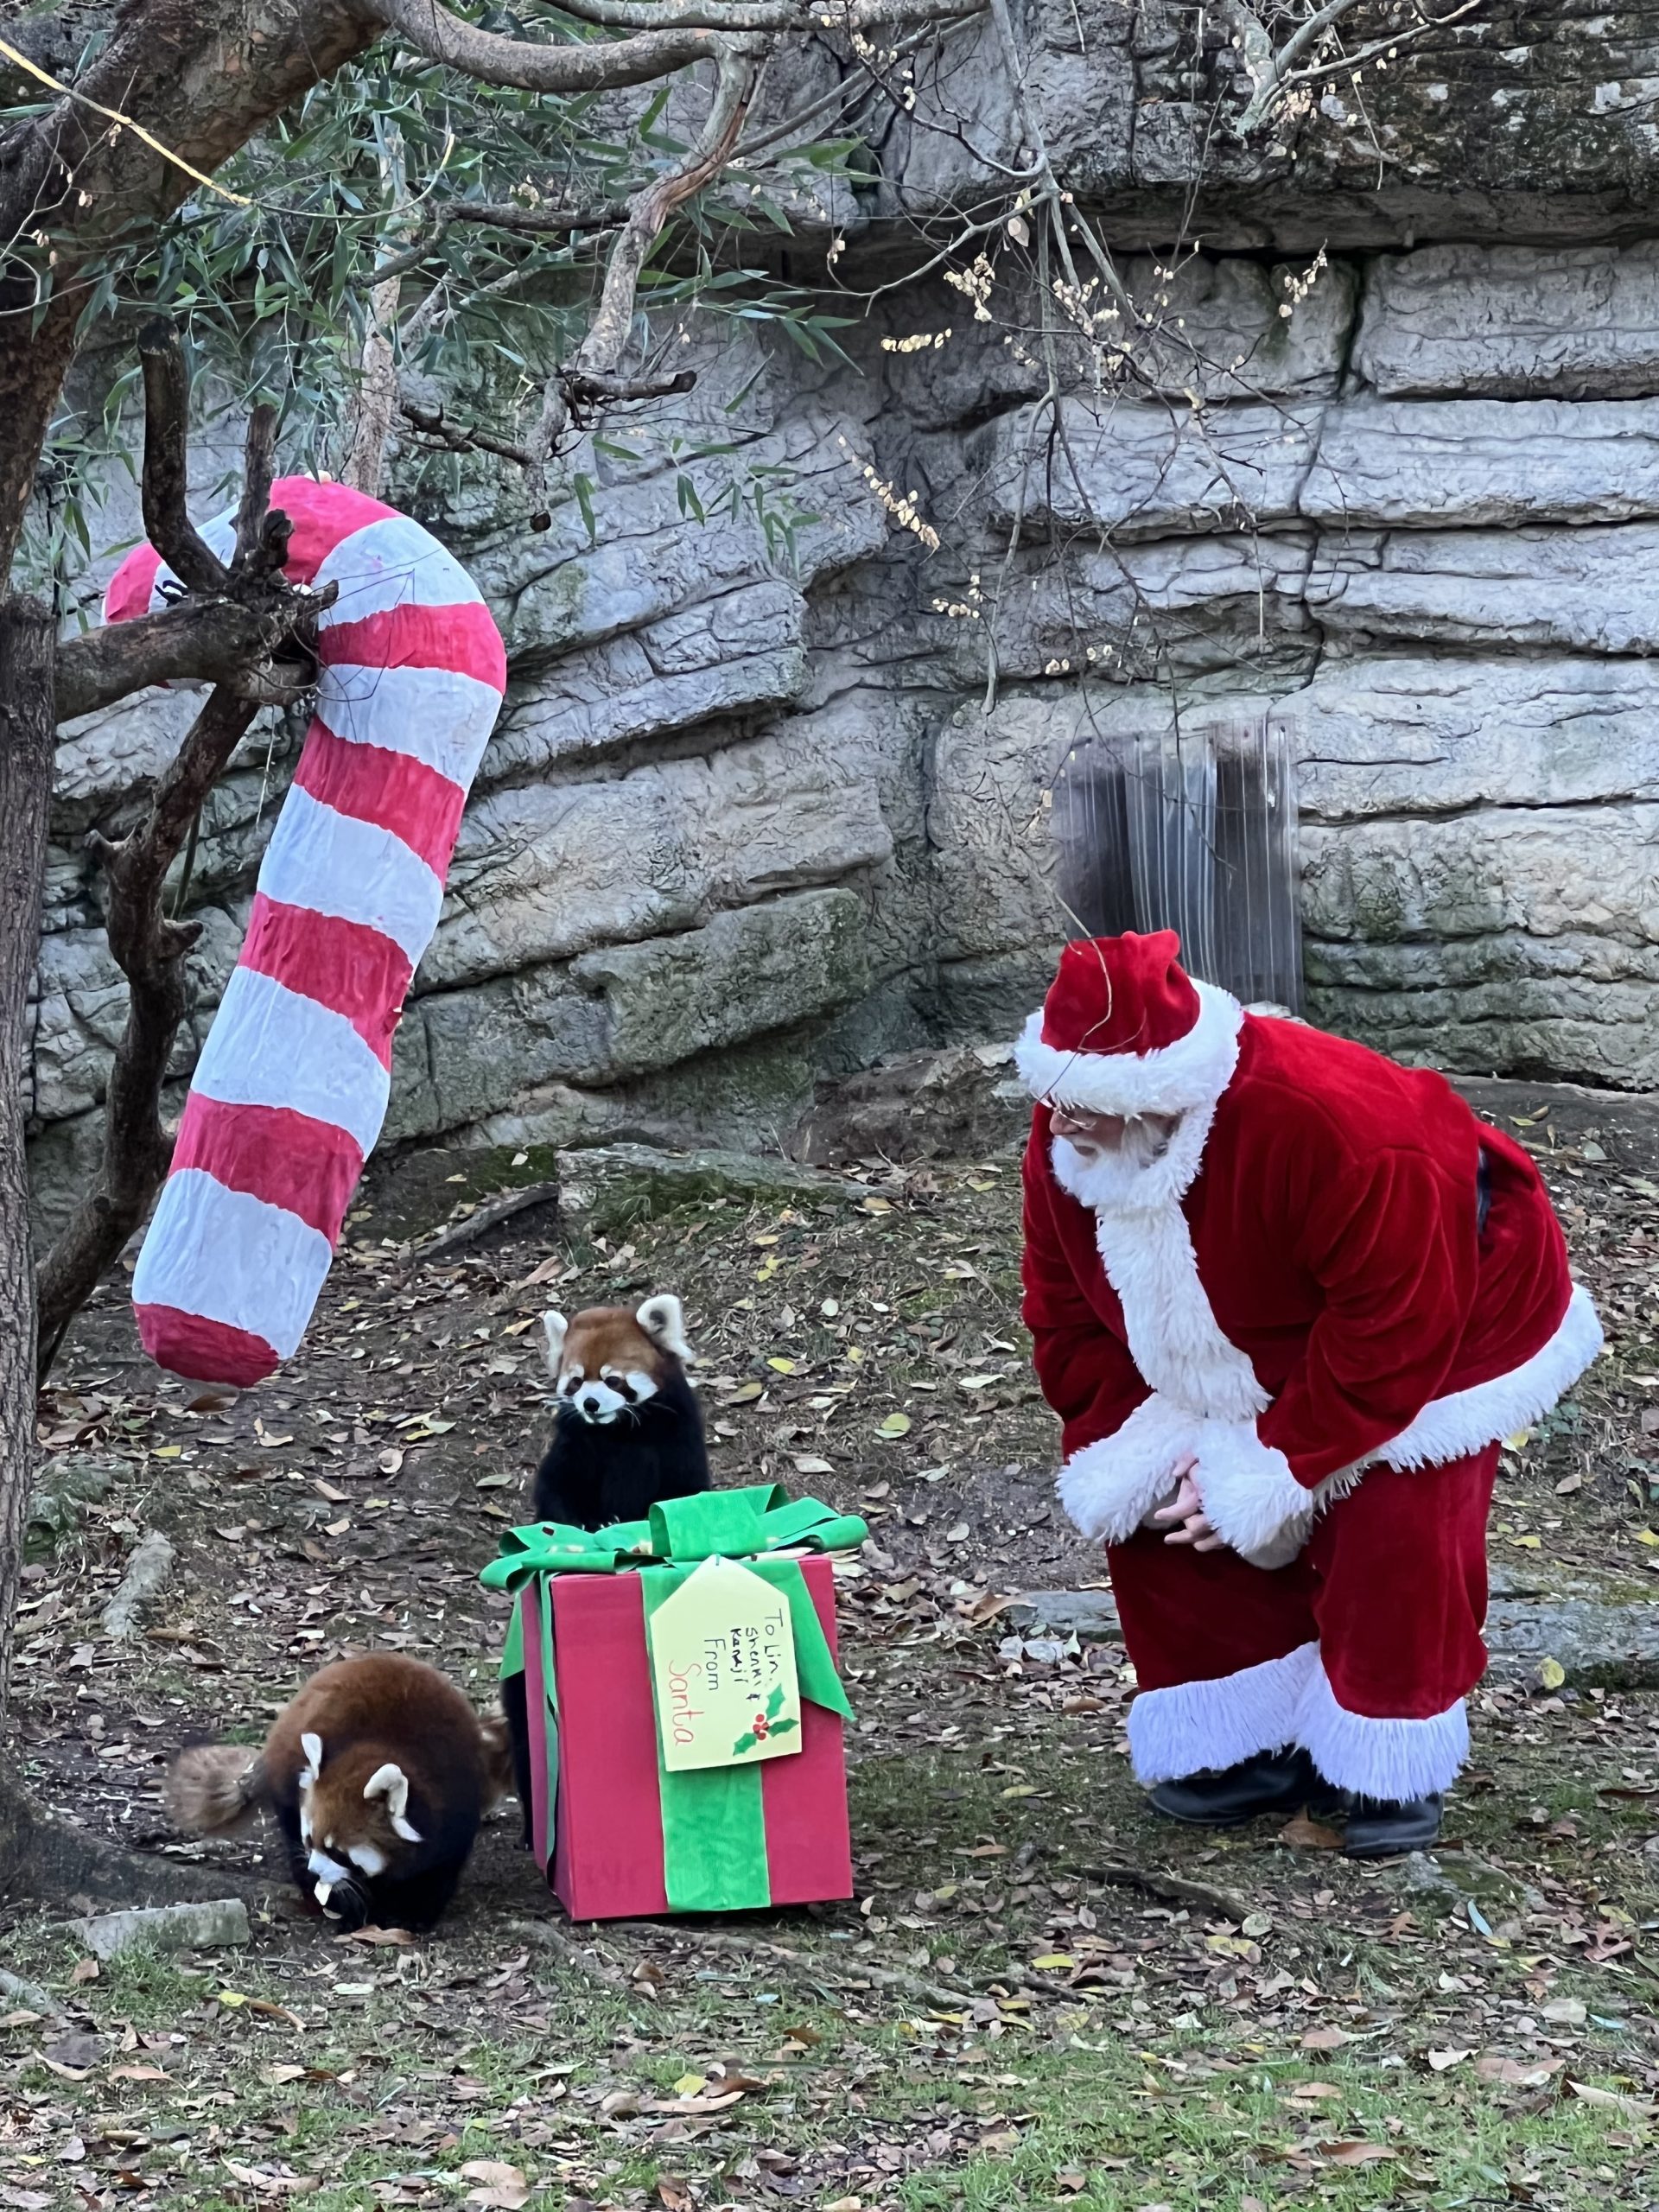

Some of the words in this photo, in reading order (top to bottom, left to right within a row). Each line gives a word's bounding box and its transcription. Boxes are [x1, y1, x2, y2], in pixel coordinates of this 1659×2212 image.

[765, 1608, 784, 1636] To
[704, 1638, 727, 1691] From
[669, 1660, 705, 1747] Santa
